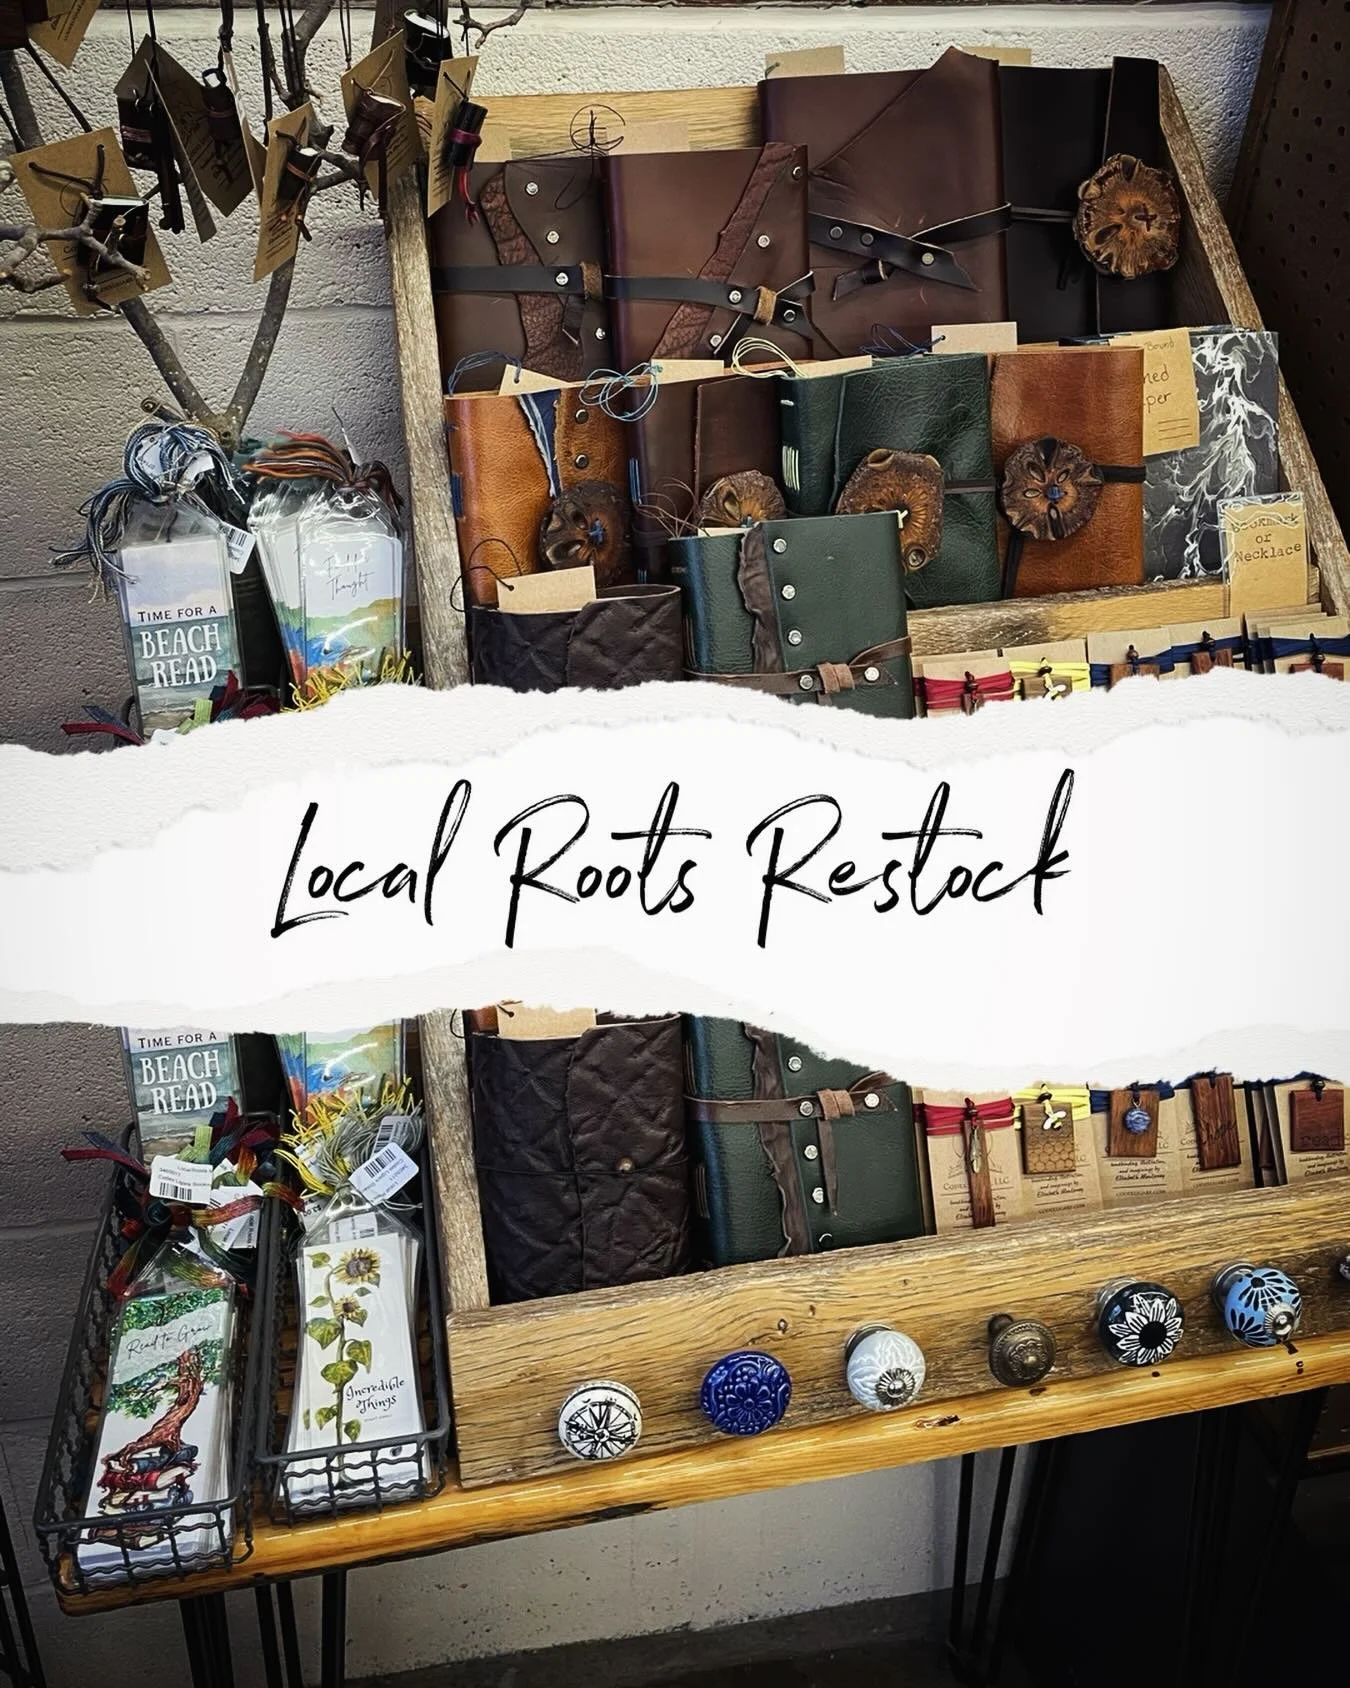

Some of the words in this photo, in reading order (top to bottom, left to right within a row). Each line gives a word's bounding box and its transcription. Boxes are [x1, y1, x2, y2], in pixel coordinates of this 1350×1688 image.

[1143, 363, 1170, 384] ned
[1144, 392, 1172, 414] per
[1255, 533, 1272, 544] or
[1235, 543, 1302, 563] Necklace
[138, 610, 172, 622] TIME
[178, 607, 203, 618] FOR
[209, 605, 217, 614] A
[140, 623, 222, 659] BEACH
[150, 655, 217, 689] READ
[138, 1037, 172, 1049] TIME
[178, 1033, 203, 1044] FOR
[209, 1031, 217, 1040] A
[140, 1049, 222, 1085] BEACH
[150, 1081, 217, 1115] READ
[126, 1334, 159, 1360] Read
[177, 1324, 213, 1343] Grow
[345, 1375, 405, 1401] Incredible
[355, 1394, 397, 1414] Things
